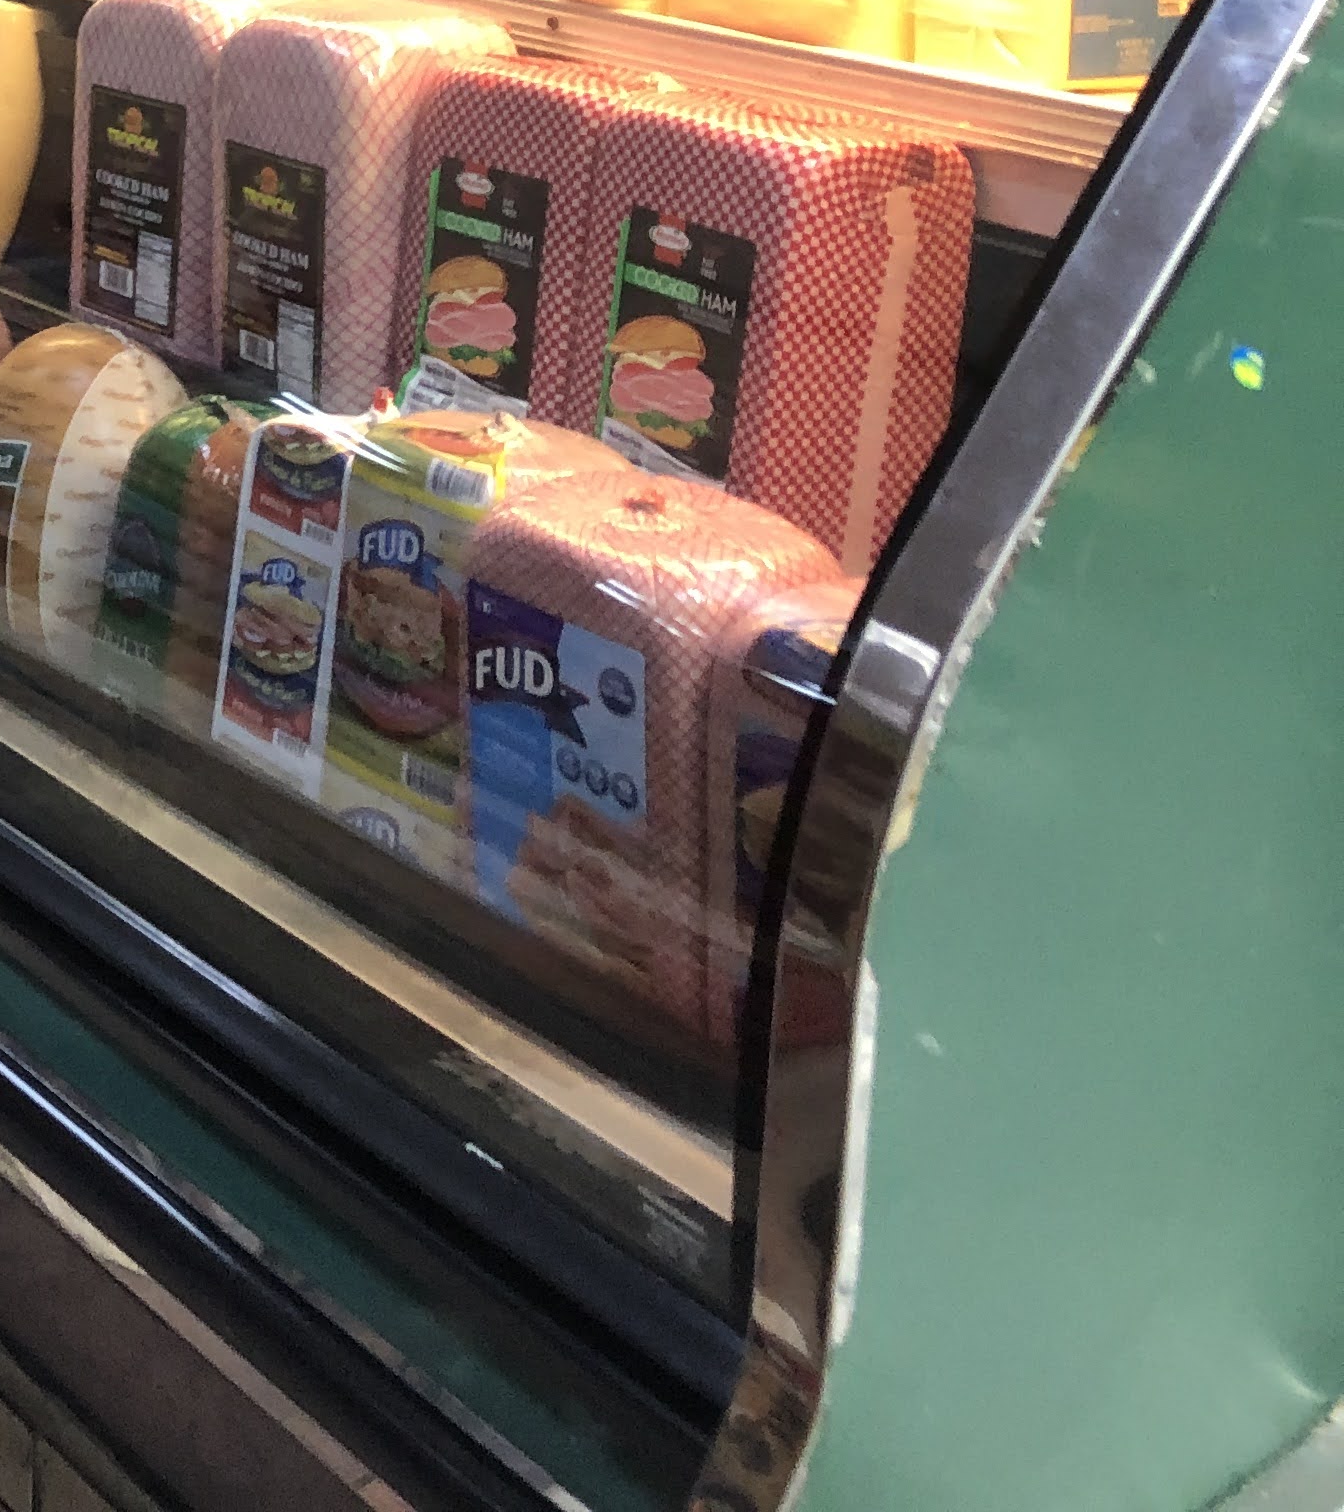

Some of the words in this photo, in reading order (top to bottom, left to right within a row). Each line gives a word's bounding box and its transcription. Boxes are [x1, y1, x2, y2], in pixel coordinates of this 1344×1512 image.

[502, 228, 534, 253] HAM
[700, 288, 737, 320] HAM
[362, 528, 421, 564] FUD
[263, 562, 296, 584] FUD
[475, 645, 555, 698] FUD
